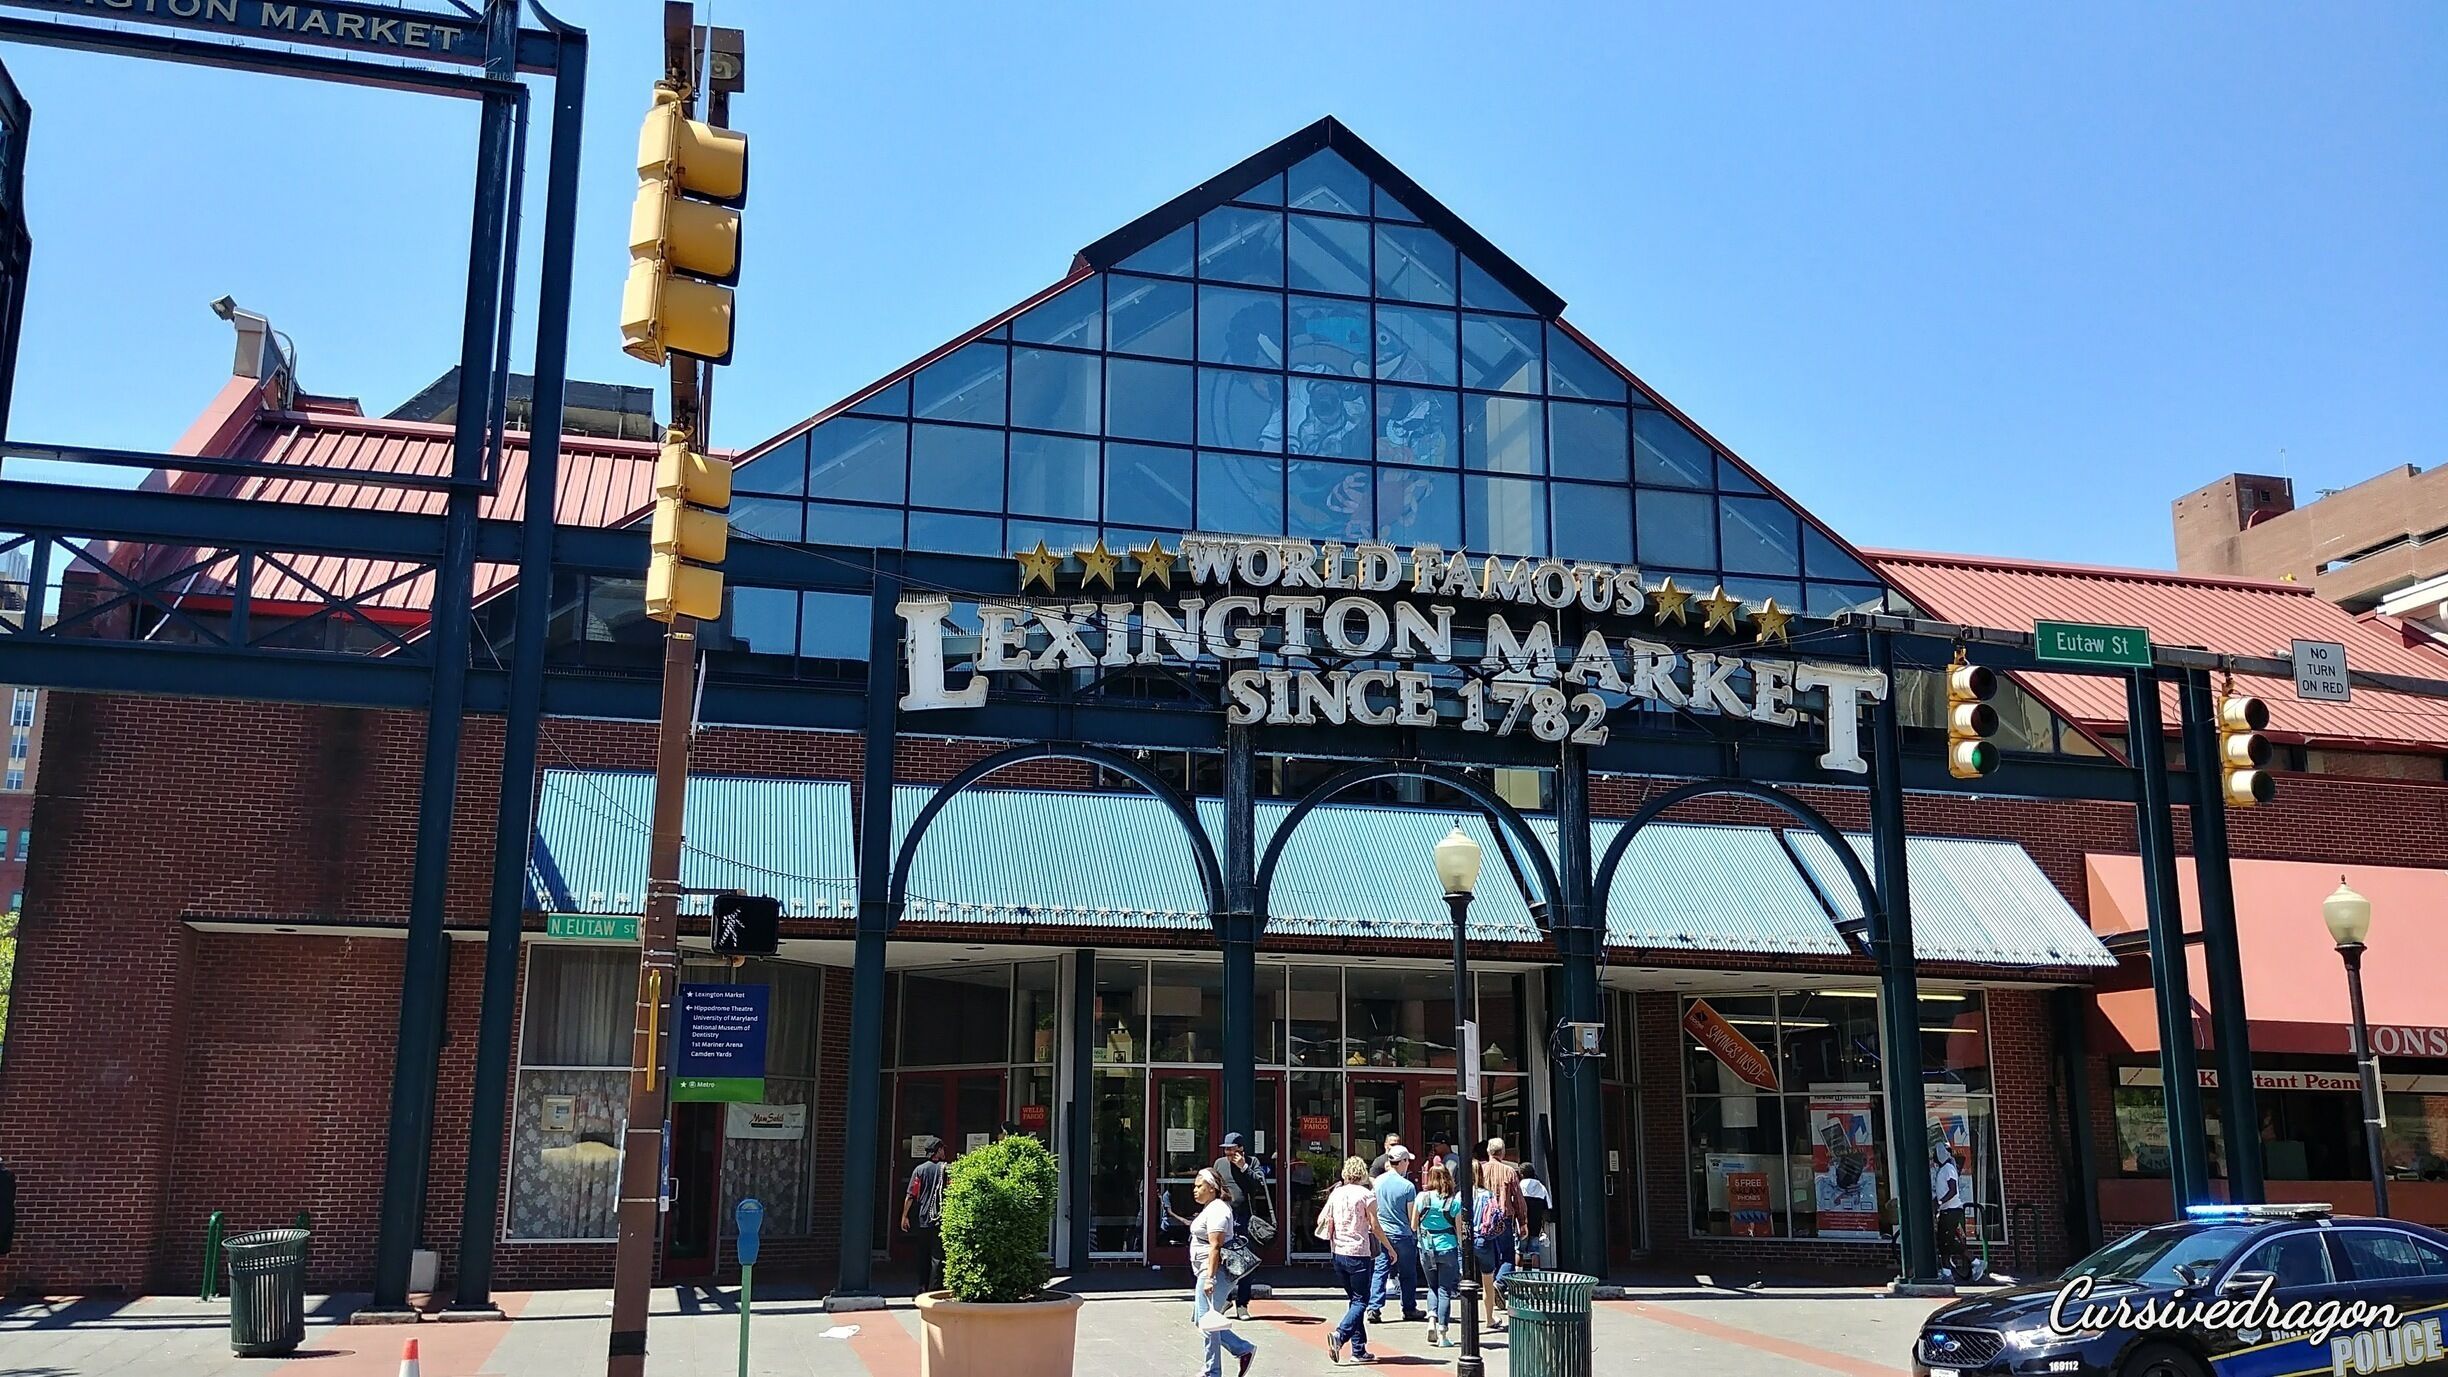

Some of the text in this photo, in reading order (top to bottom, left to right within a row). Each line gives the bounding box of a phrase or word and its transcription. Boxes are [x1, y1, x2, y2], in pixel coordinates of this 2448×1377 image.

[260, 2, 461, 50] MARKET
[1182, 538, 1645, 616] WORLD FAMOUS
[2056, 631, 2129, 655] Eutaw St
[2310, 647, 2328, 659] NO
[2307, 663, 2336, 677] TURN
[895, 596, 1887, 774] LEXINGTON MARKET
[2302, 679, 2344, 694] ON RED
[1228, 669, 1609, 747] SINCE 1782
[551, 918, 636, 936] N. EUTAW ST
[693, 1014, 722, 1022] University
[1706, 1024, 1769, 1081] SAVINGS INSIDE
[1740, 1178, 1762, 1187] FREE
[2331, 1318, 2444, 1377] POLICE
[2049, 1361, 2079, 1372] 169112
